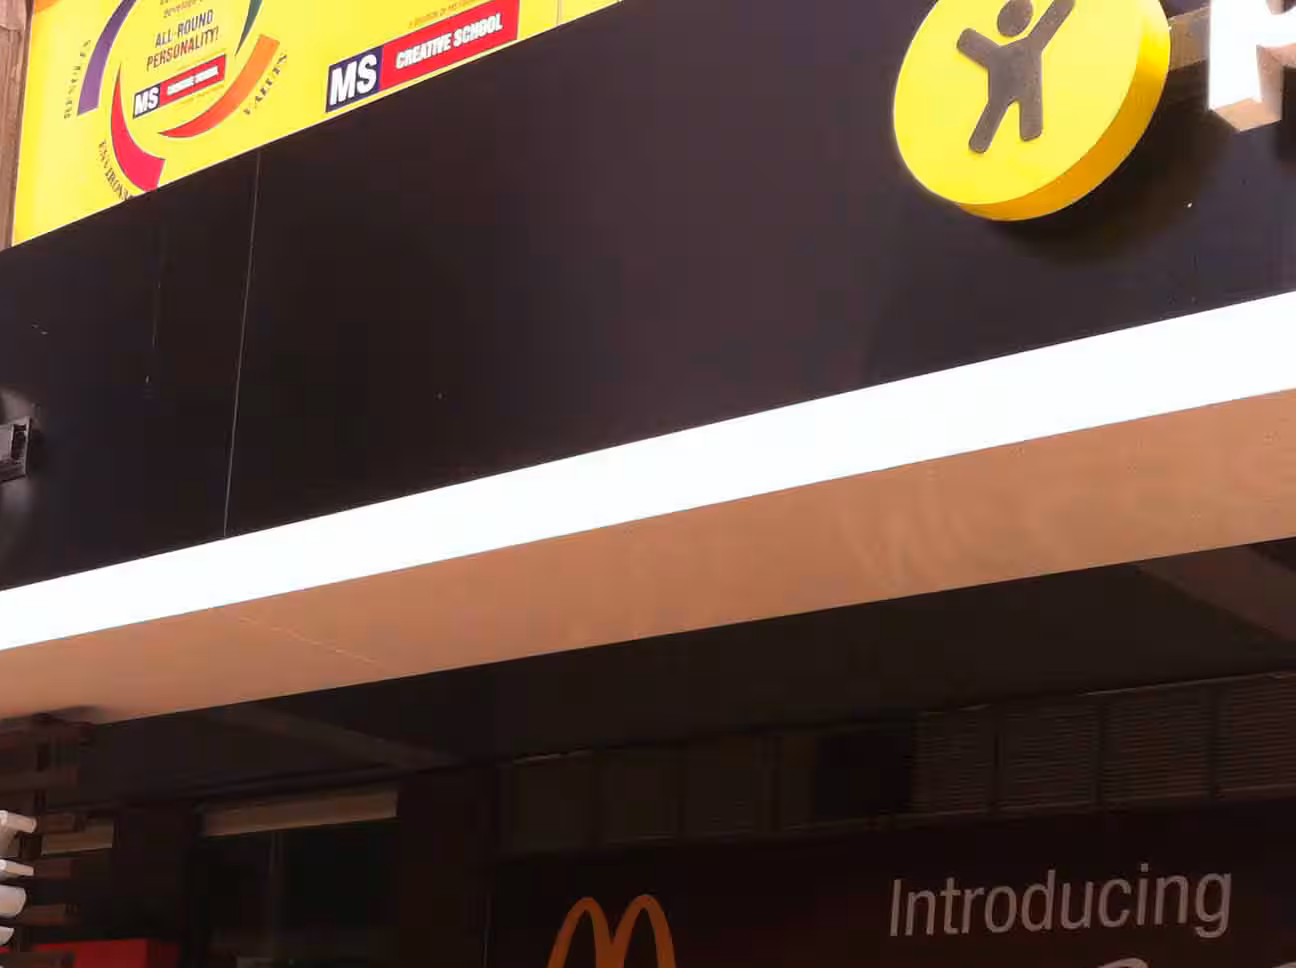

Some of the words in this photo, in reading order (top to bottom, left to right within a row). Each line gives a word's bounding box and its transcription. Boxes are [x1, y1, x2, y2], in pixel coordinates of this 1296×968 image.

[329, 54, 378, 106] MS
[395, 33, 452, 69] CREATIVE
[453, 13, 503, 47] SCHOOL
[134, 86, 160, 115] MS
[889, 863, 1233, 939] Introducing
